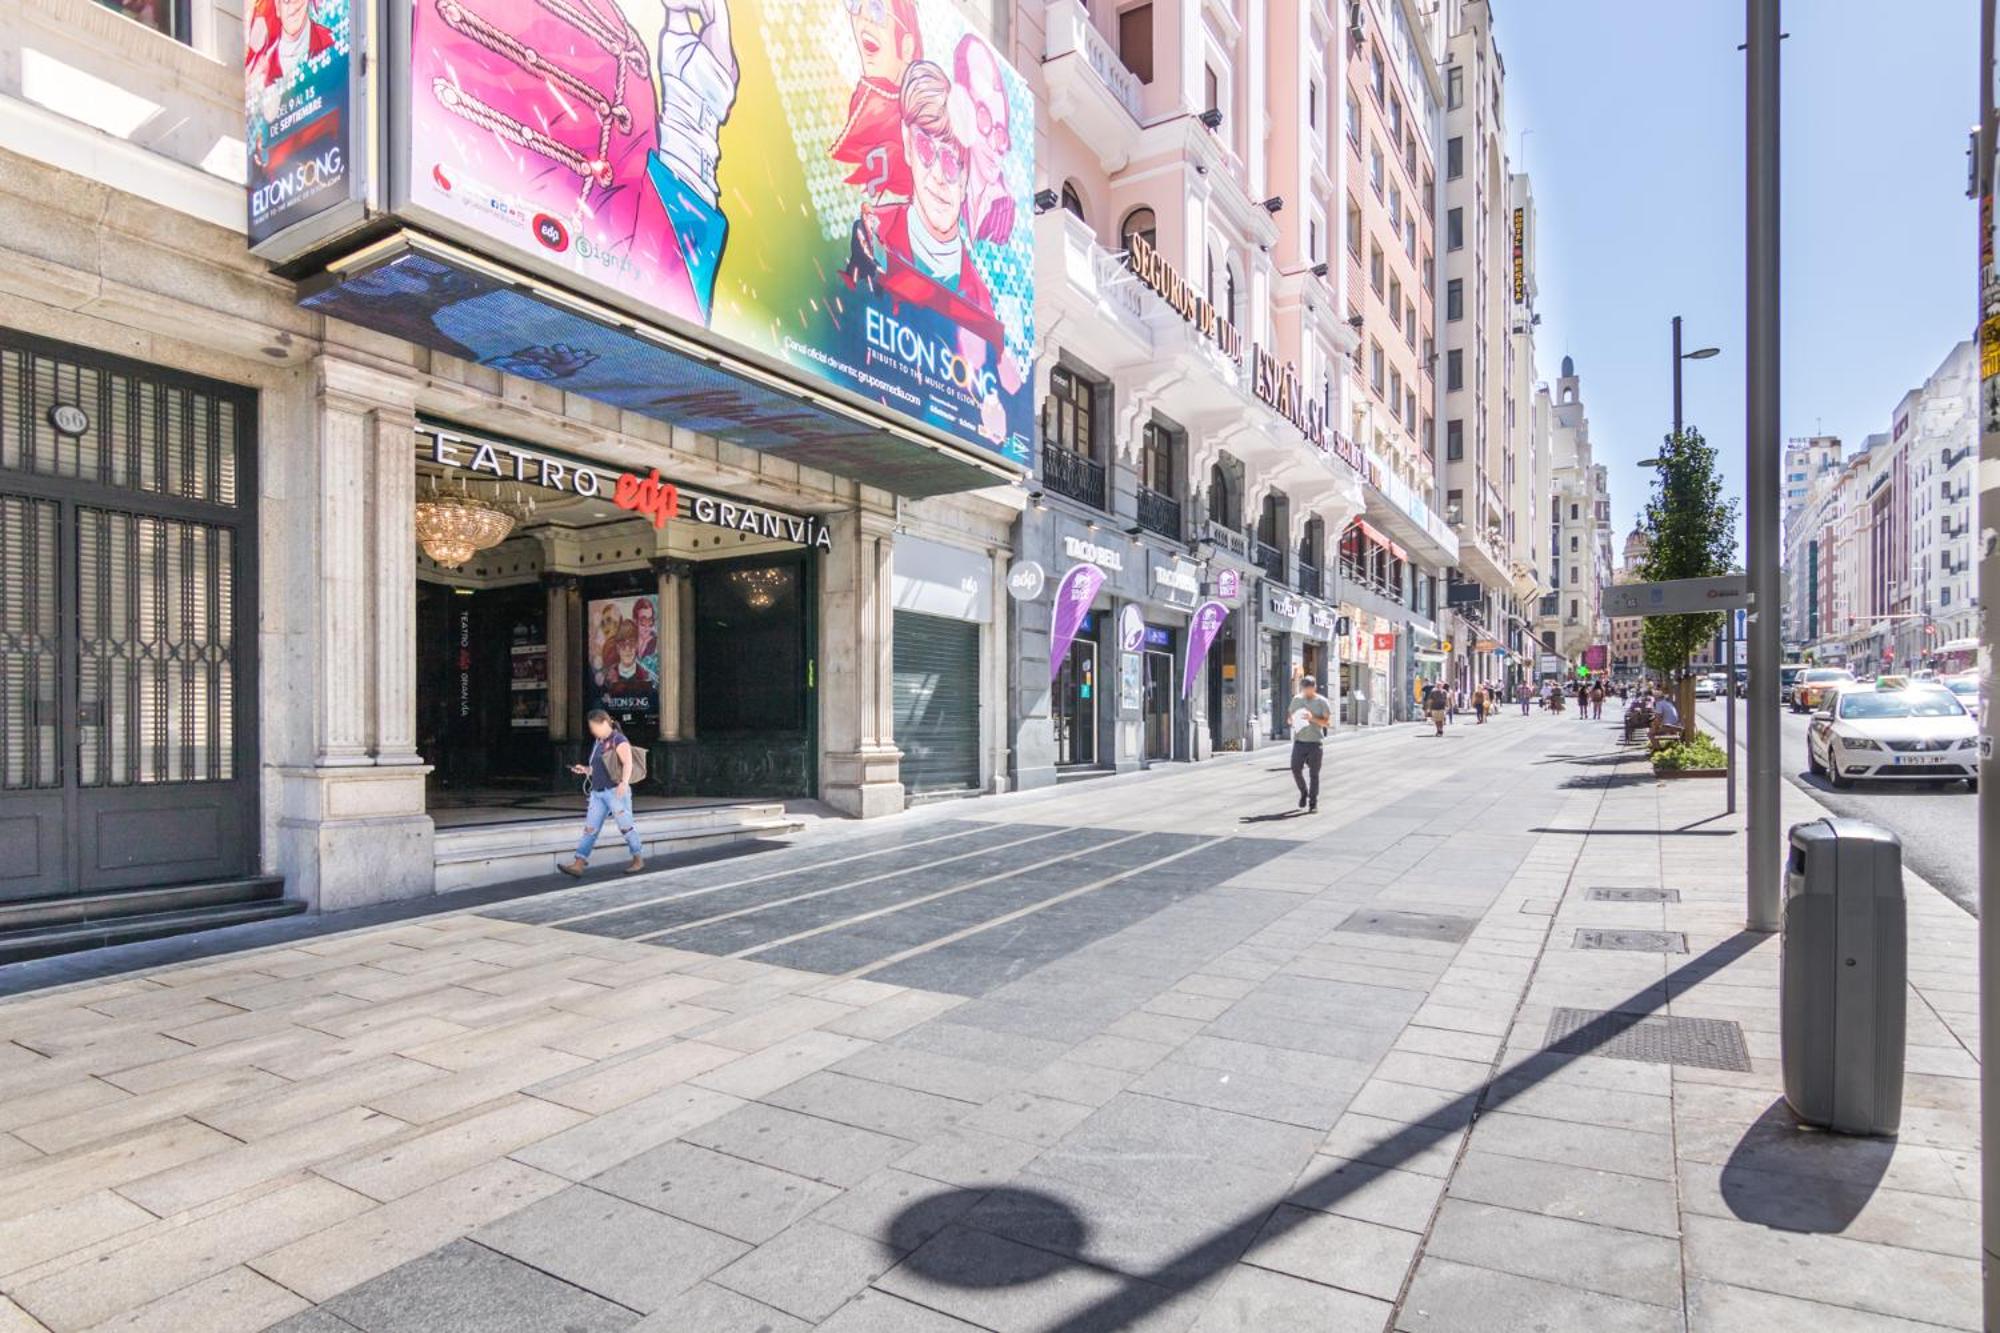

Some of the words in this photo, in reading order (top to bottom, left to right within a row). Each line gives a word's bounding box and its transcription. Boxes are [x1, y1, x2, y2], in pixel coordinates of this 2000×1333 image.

[305, 85, 316, 101] 15
[280, 96, 323, 132] SEPTIEMBRE
[252, 172, 293, 217] ELTON
[540, 223, 560, 243] edp
[1132, 231, 1196, 322] SEGUROS
[1196, 297, 1216, 340] DE
[865, 305, 935, 374] ELTON
[940, 347, 998, 400] SONG
[867, 346, 898, 371] TRIBUTE
[899, 363, 910, 375] TO
[924, 375, 946, 394] MUSIC
[946, 386, 956, 398] OF
[59, 410, 84, 429] 66
[612, 468, 679, 530] edp
[691, 497, 780, 539] GRAN
[1064, 535, 1097, 562] TACO
[1095, 545, 1124, 572] BELL
[961, 575, 979, 596] edp
[1011, 569, 1037, 591] edp
[460, 611, 470, 648] TEATRO
